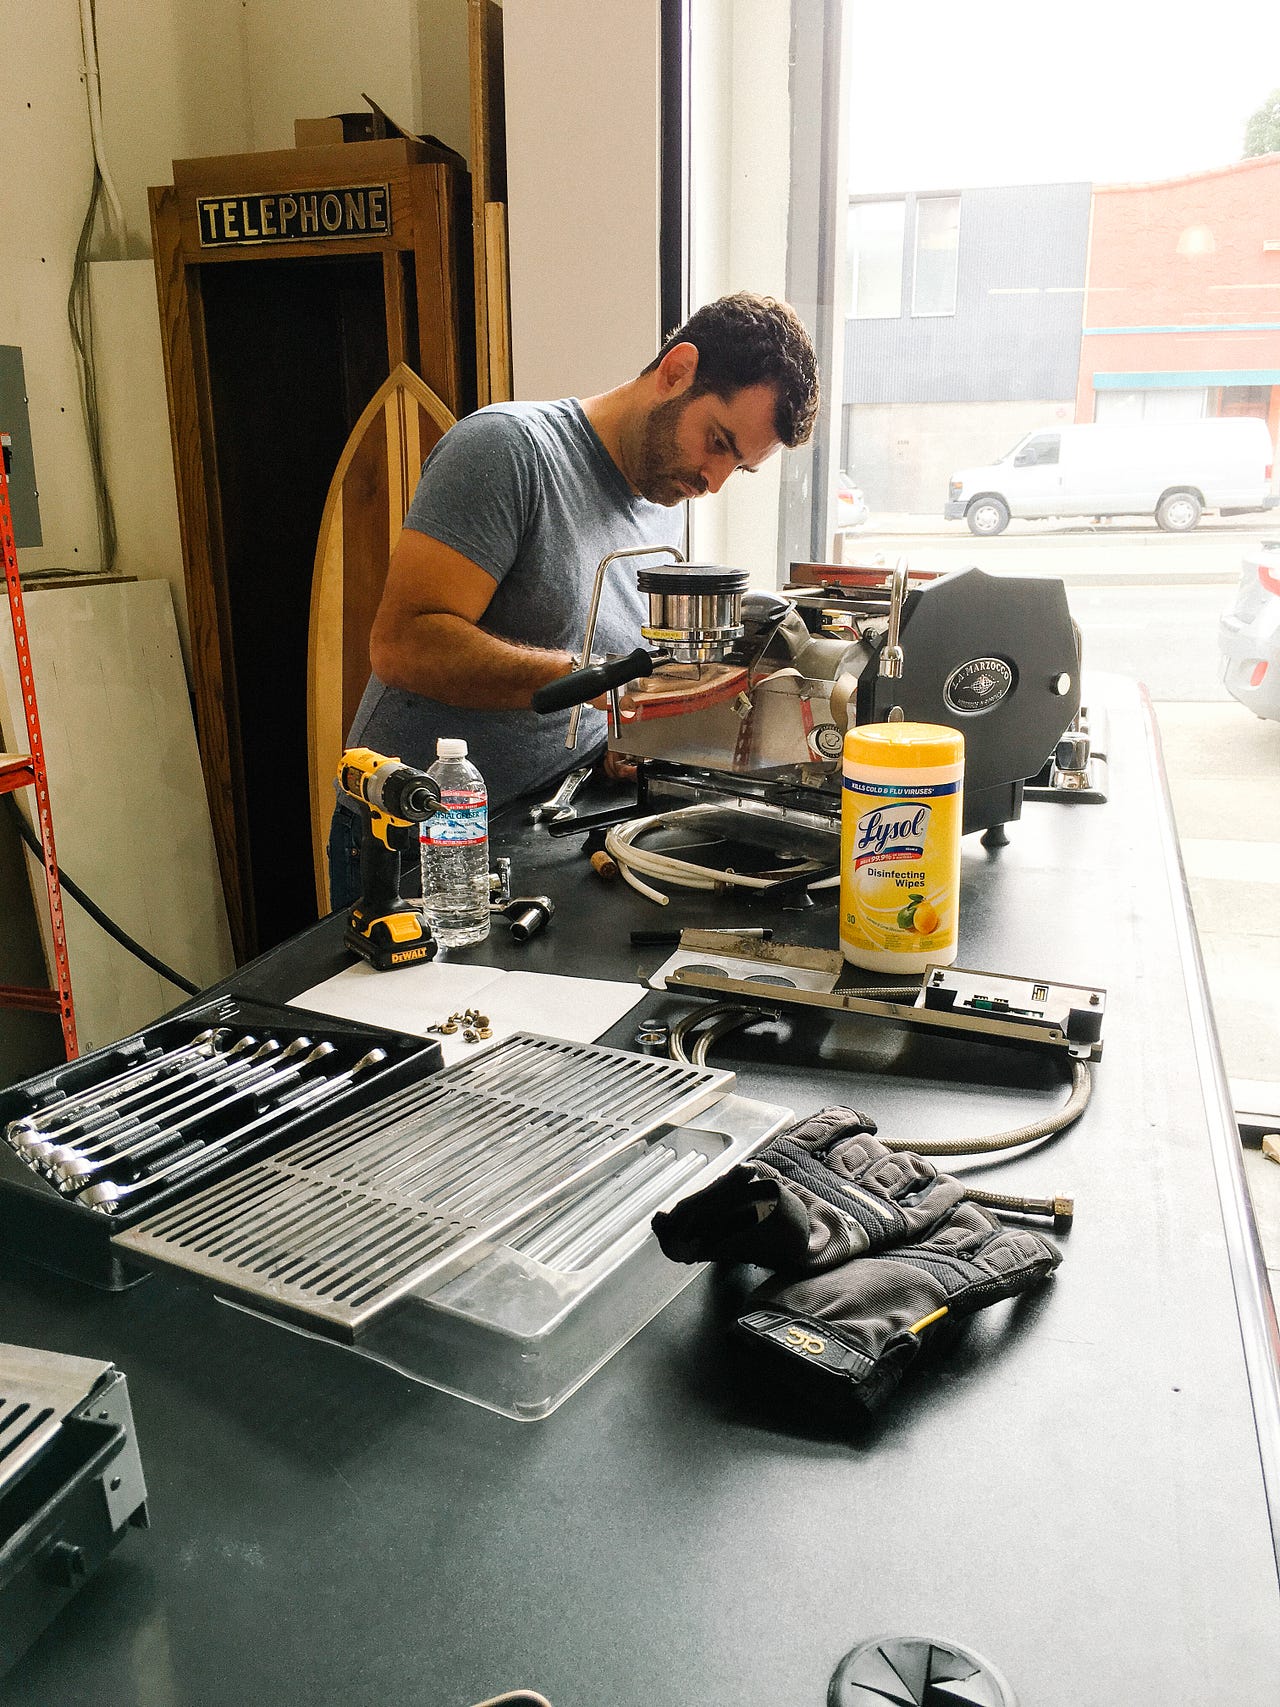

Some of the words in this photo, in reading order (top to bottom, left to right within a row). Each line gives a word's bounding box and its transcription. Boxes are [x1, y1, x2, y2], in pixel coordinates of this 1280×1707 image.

[203, 190, 386, 239] TELEPHONE
[952, 673, 965, 690] LA
[965, 661, 1009, 680] MARZOCCO
[851, 782, 866, 792] KILLS
[866, 785, 883, 794] COLD
[858, 808, 925, 853] Lysol
[871, 853, 892, 863] 99.9%
[867, 867, 926, 880] Disinfecting
[895, 879, 925, 889] Wipes
[846, 912, 856, 924] 80
